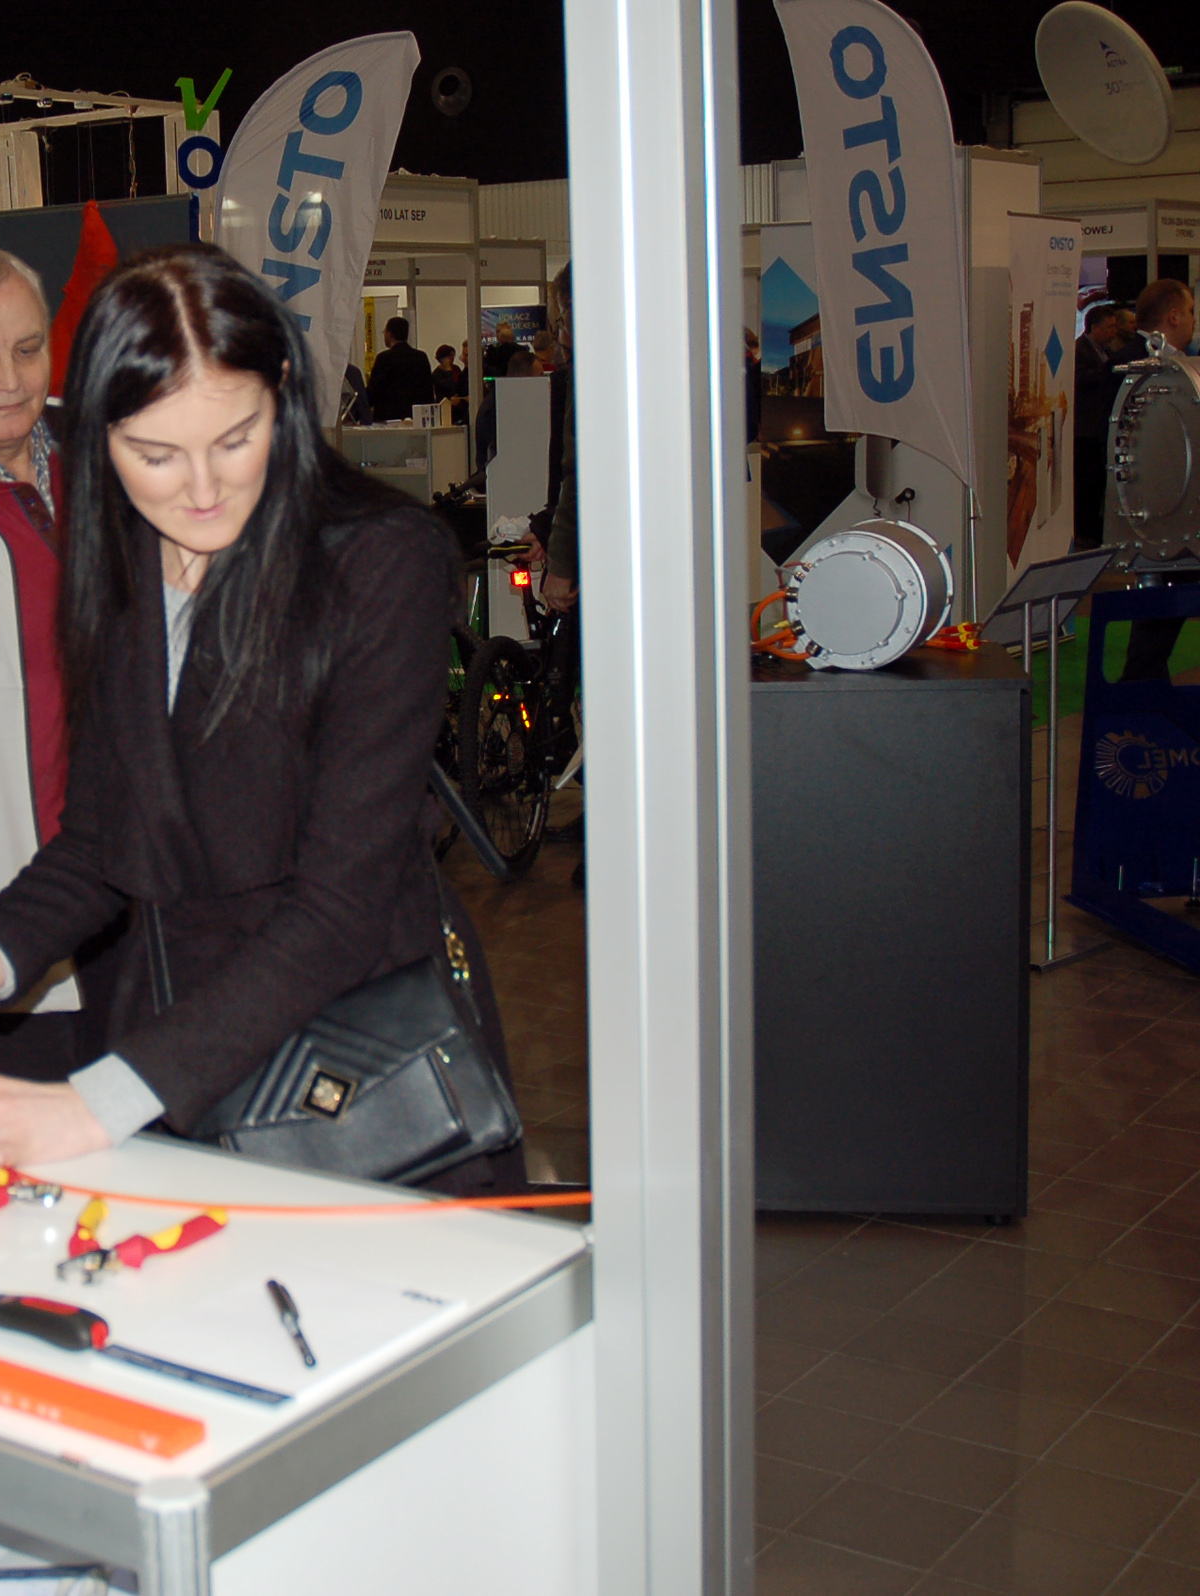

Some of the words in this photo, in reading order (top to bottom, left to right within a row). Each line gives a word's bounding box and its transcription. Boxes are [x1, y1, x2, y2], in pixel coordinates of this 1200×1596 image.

[261, 70, 363, 332] NSTO
[380, 208, 393, 220] 100
[394, 209, 409, 221] LAT
[411, 210, 427, 221] SEP
[1081, 225, 1114, 236] OWEJ
